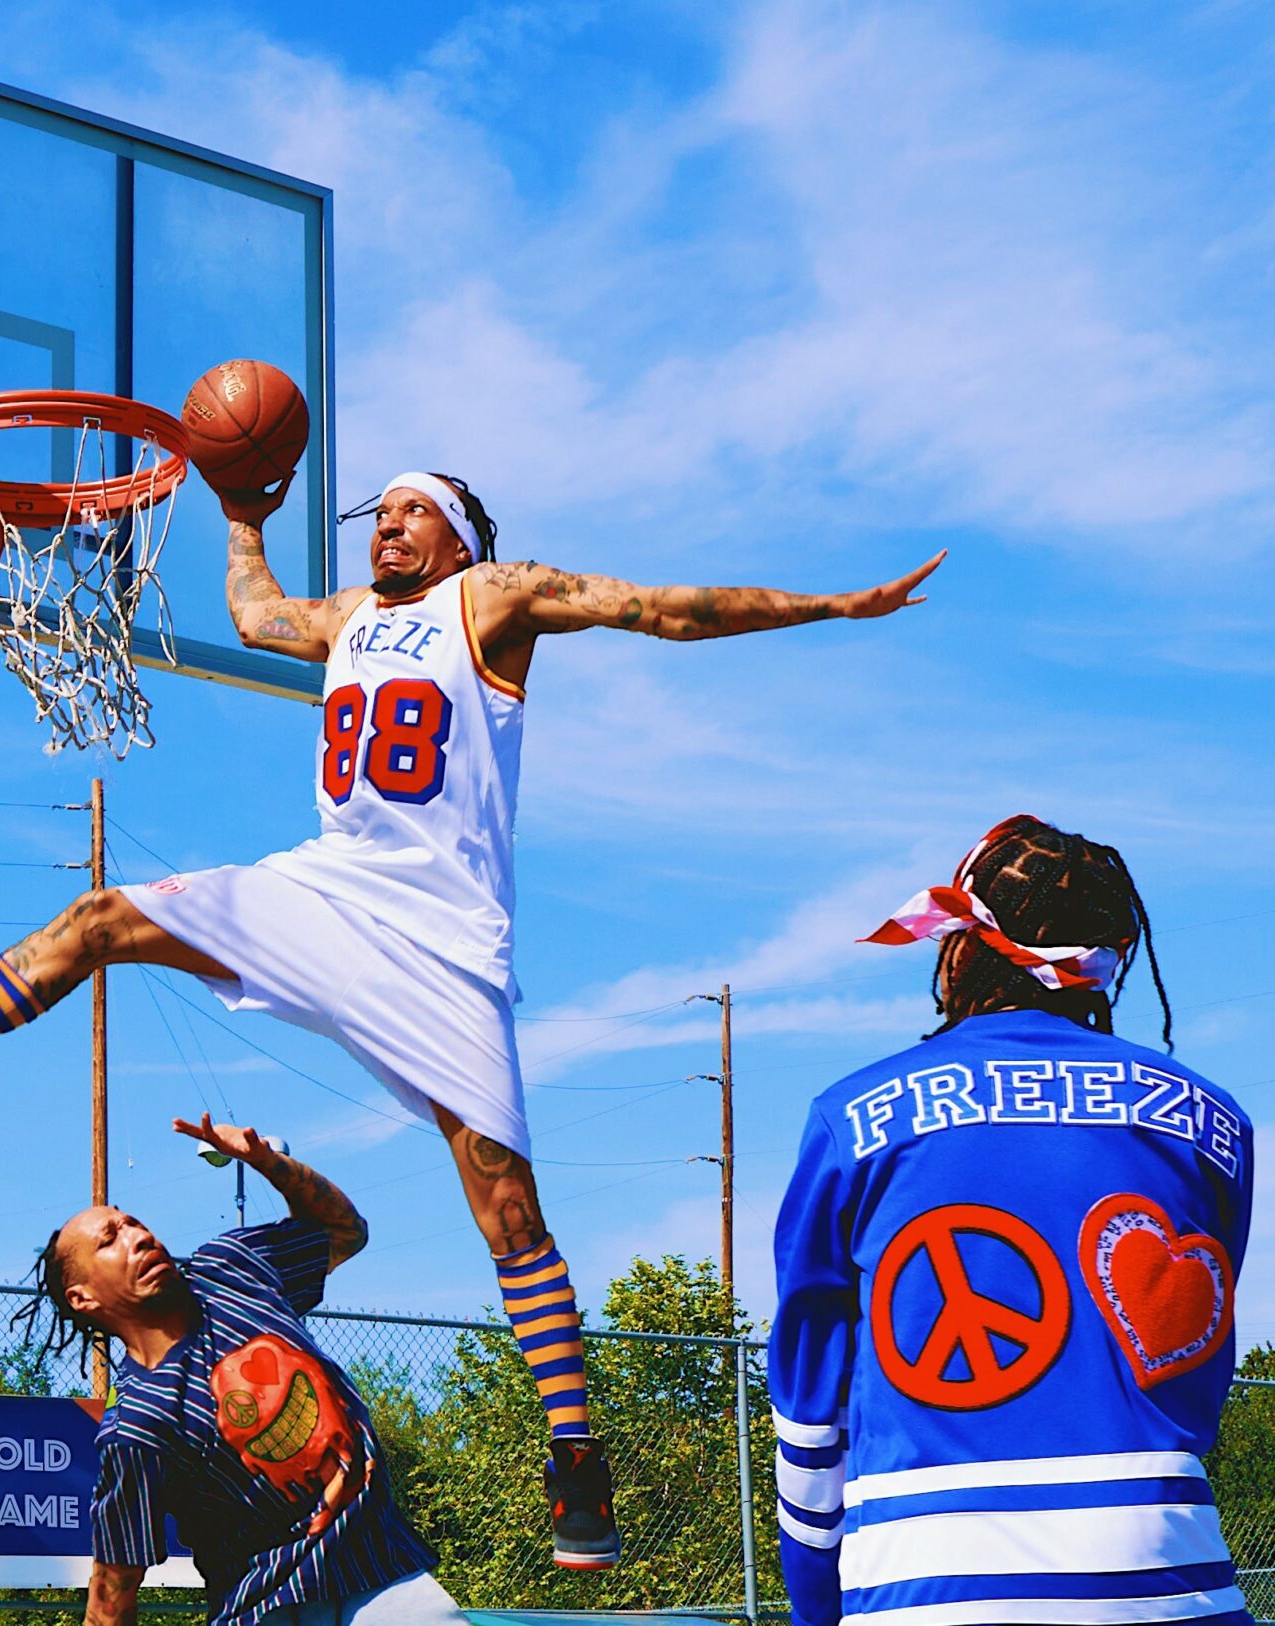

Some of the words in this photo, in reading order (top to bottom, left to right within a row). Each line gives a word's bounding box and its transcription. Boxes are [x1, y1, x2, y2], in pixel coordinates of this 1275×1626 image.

[349, 619, 442, 670] FREZE
[323, 677, 453, 807] 88
[845, 1060, 1241, 1179] FREEZE
